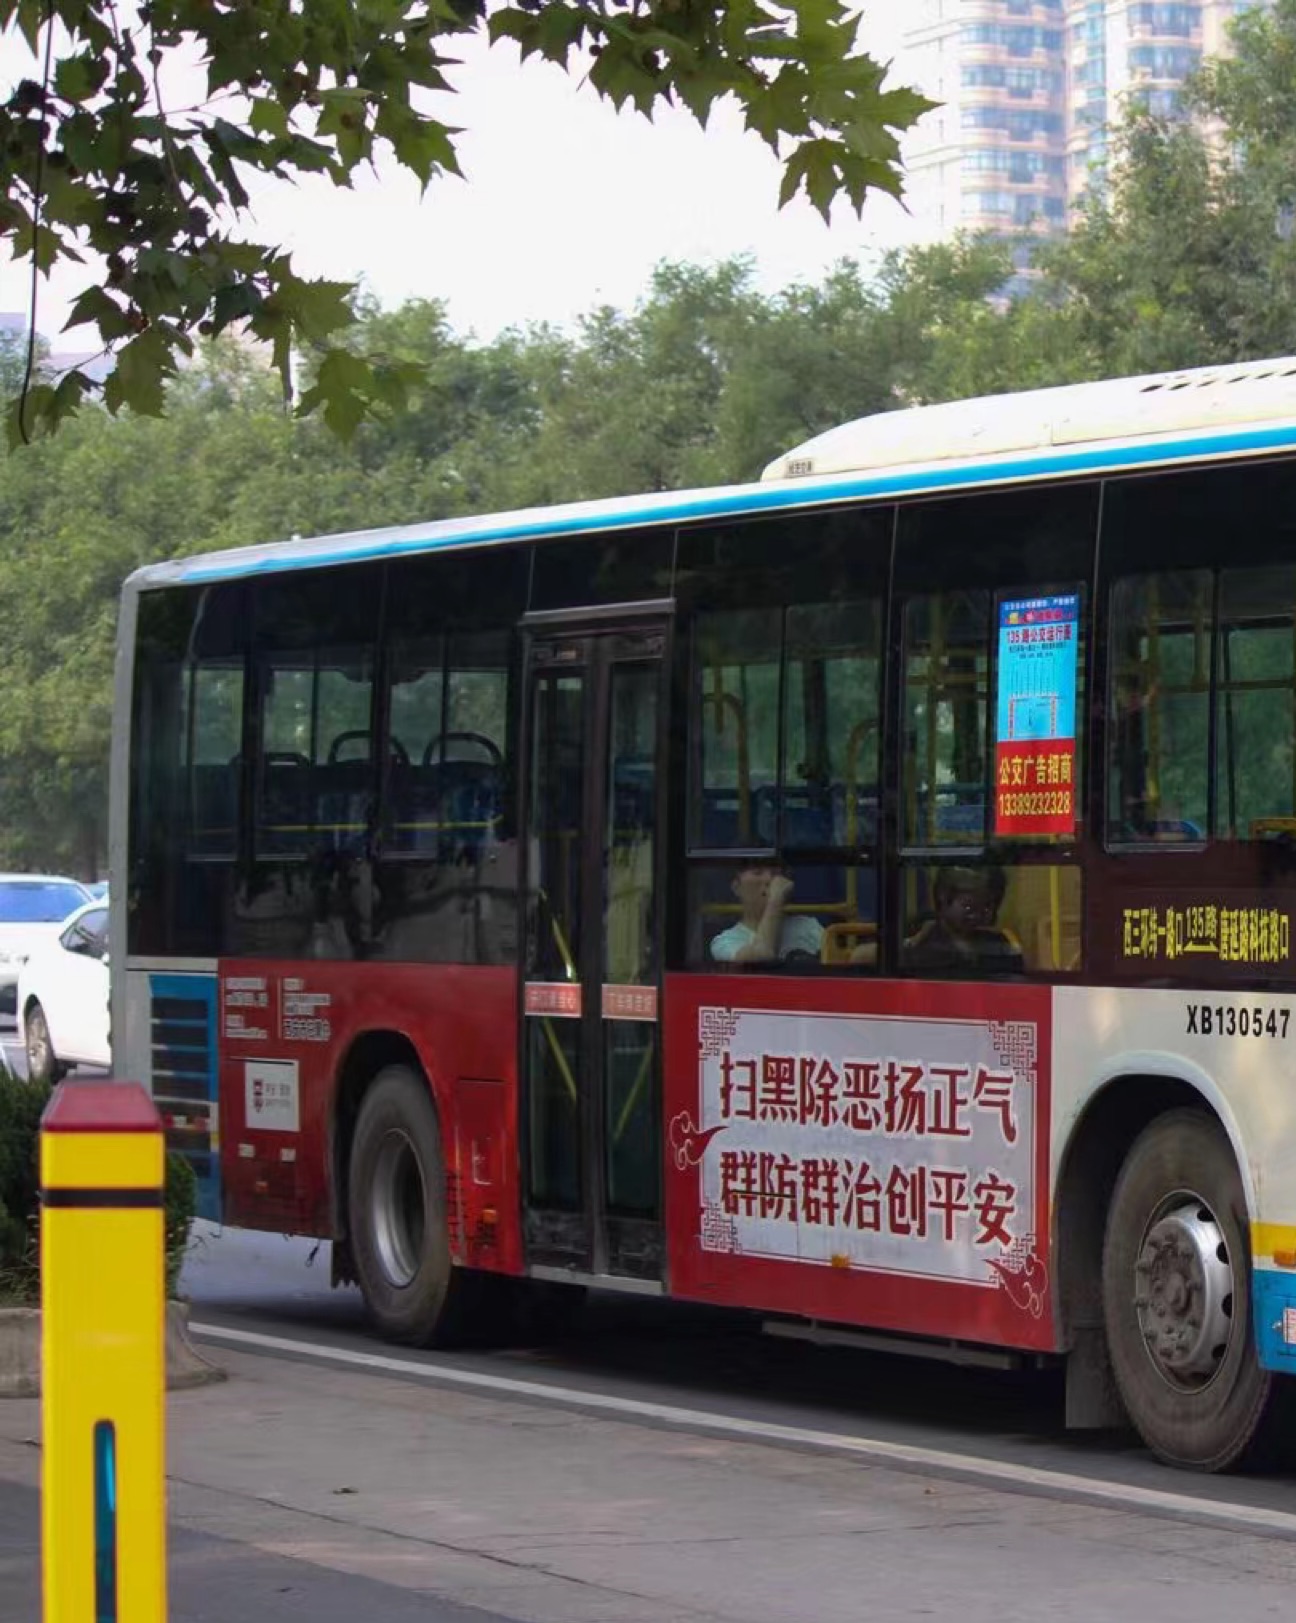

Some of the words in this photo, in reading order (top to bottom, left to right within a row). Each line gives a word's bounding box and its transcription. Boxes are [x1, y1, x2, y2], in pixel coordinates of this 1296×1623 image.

[1000, 754, 1072, 786] 公交广告招商
[1186, 1004, 1291, 1038] XB130547
[719, 1051, 1017, 1143] 扫黑除恶扬正气
[720, 1150, 1016, 1246] 群防群治创平安
